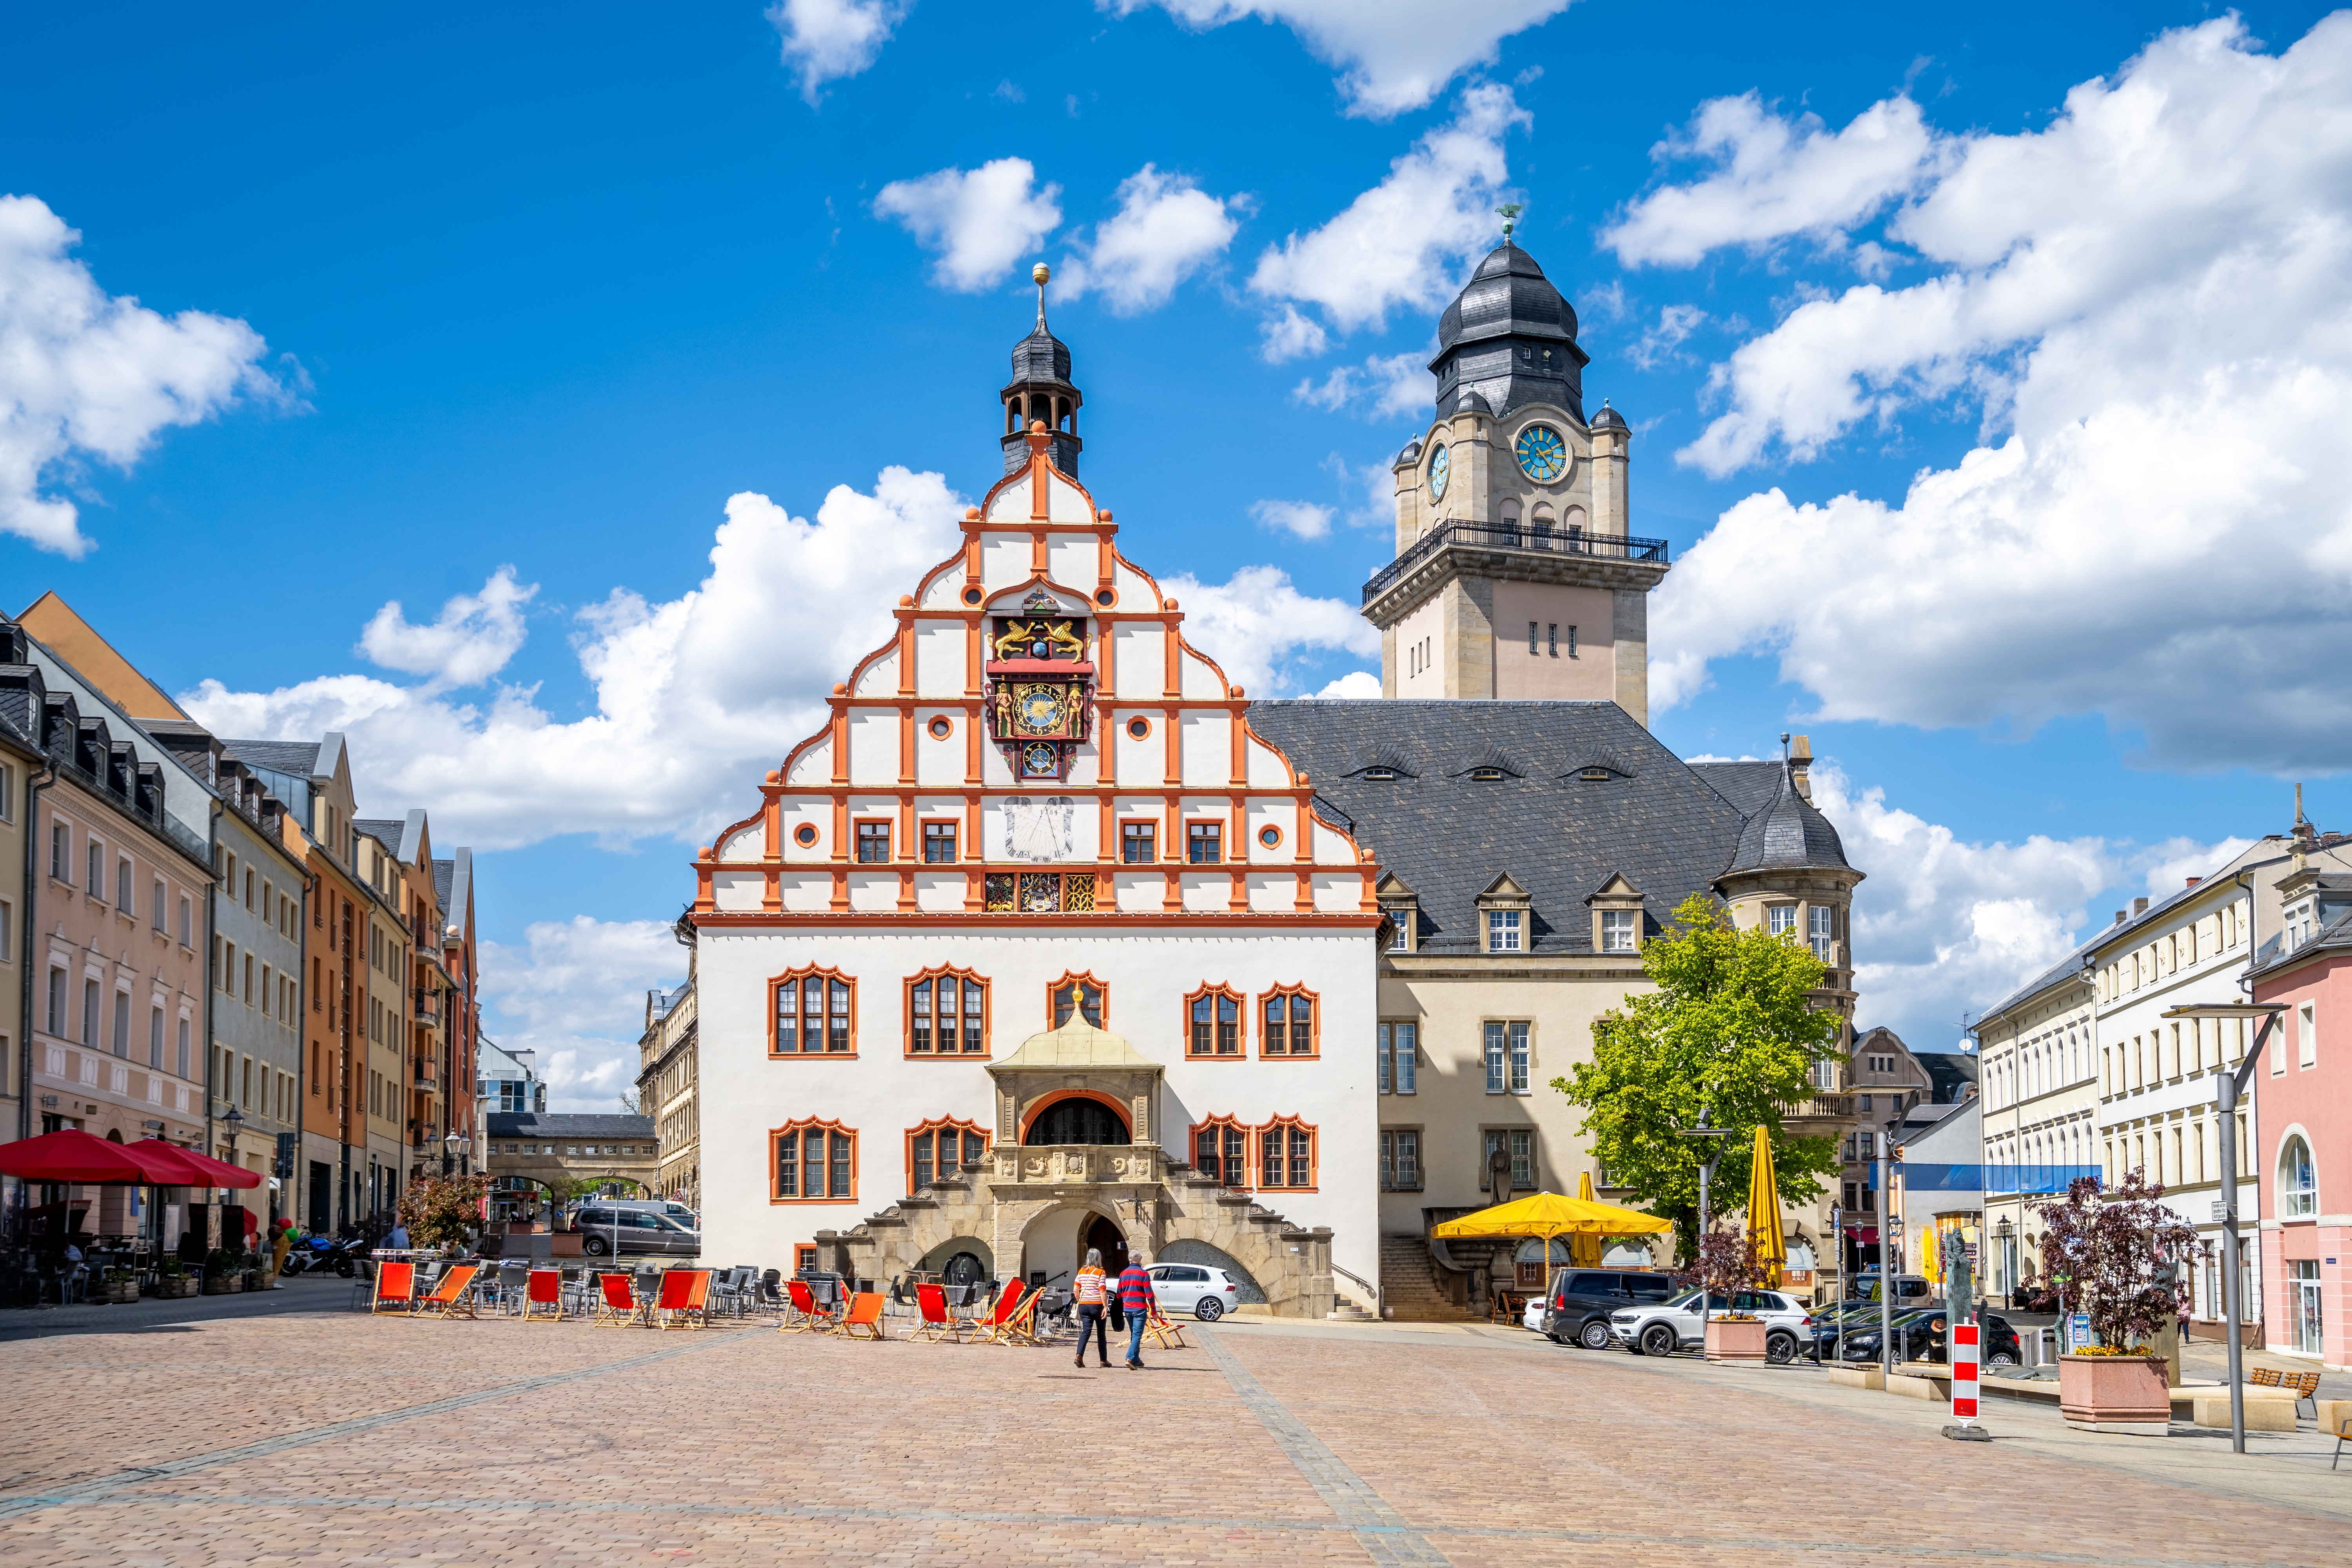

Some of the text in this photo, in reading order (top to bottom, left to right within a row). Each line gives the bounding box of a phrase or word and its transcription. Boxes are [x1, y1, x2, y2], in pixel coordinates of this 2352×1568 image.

[1035, 684, 1044, 693] 12
[1017, 695, 1025, 703] 10
[1056, 695, 1062, 703] 2
[1015, 705, 1021, 714] 9
[1018, 716, 1024, 725] 8
[1056, 716, 1062, 724] 4
[1025, 724, 1031, 732] 7
[1036, 727, 1043, 735] 6
[1048, 724, 1055, 732] 5
